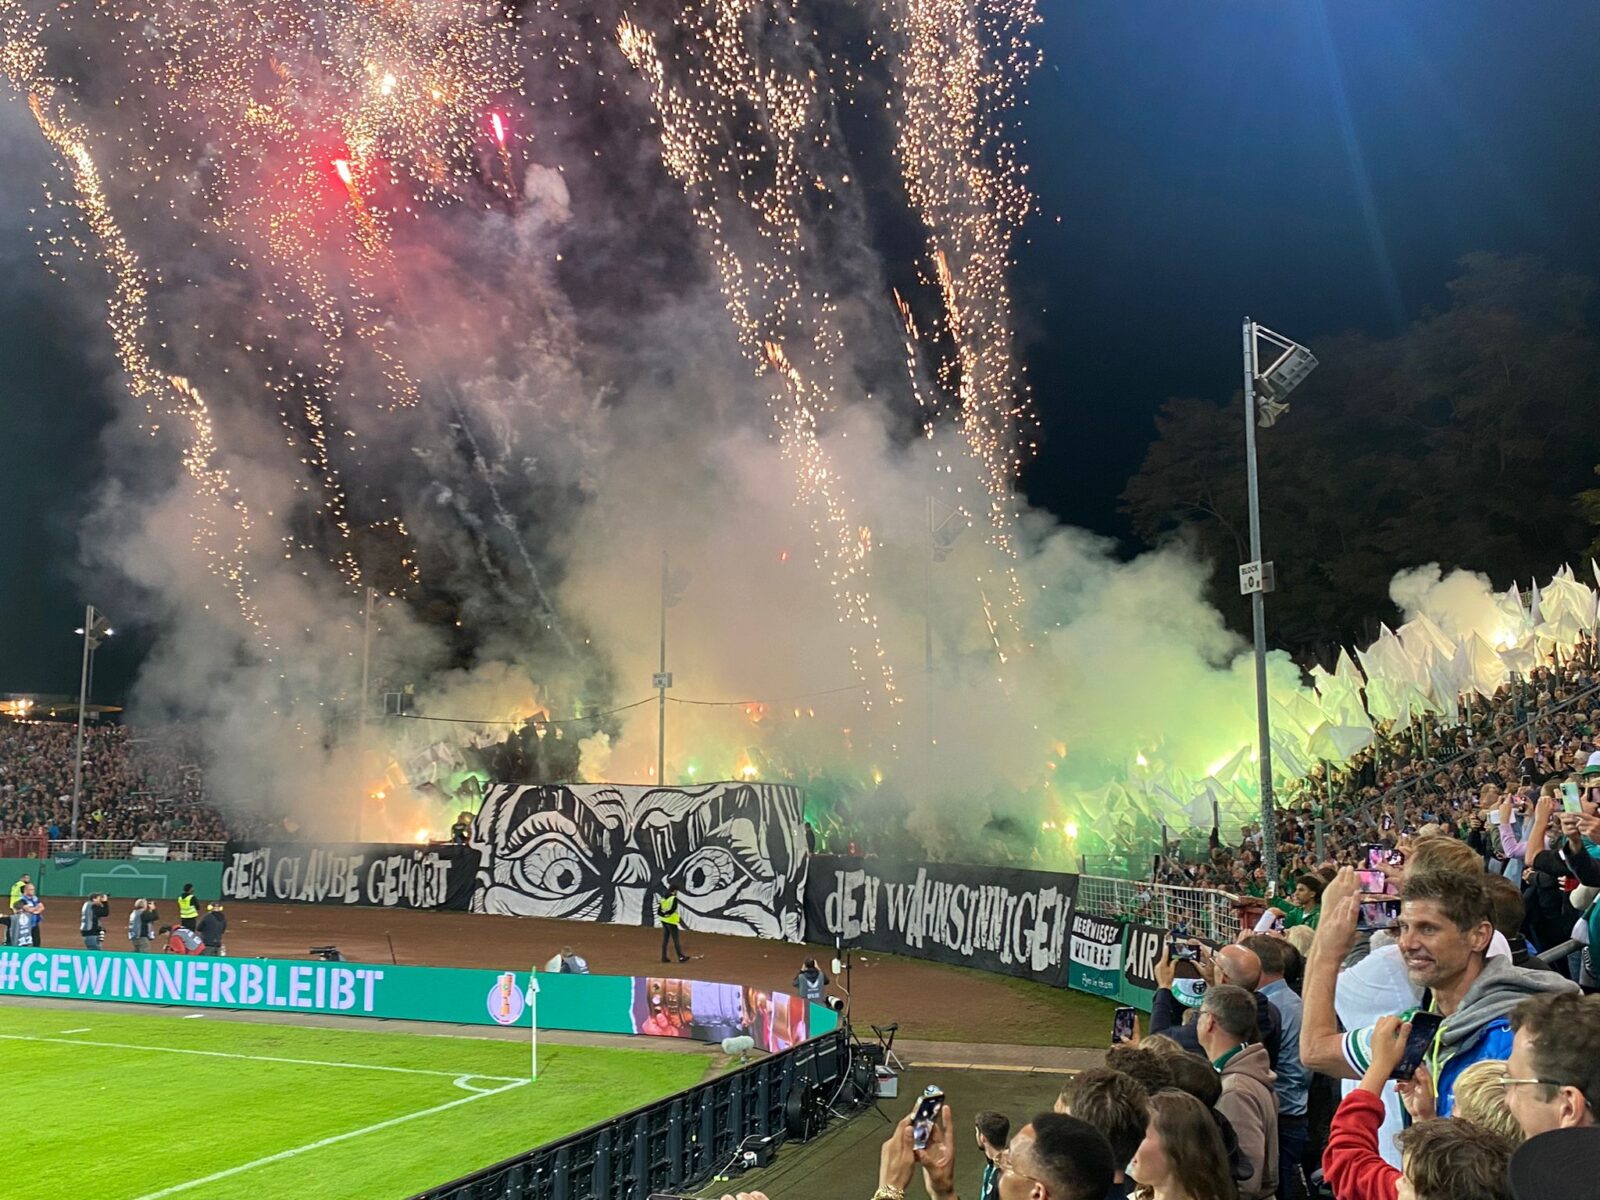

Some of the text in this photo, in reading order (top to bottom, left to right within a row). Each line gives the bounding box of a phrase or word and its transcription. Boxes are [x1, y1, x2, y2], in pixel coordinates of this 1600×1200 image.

[1241, 565, 1258, 575] BLOCK
[272, 848, 364, 905] GLAUBE
[366, 849, 452, 909] GEHÖRT
[884, 867, 1072, 972] WAHNSINNIGEN
[0, 951, 385, 1012] #GEWINNERBLEIBT
